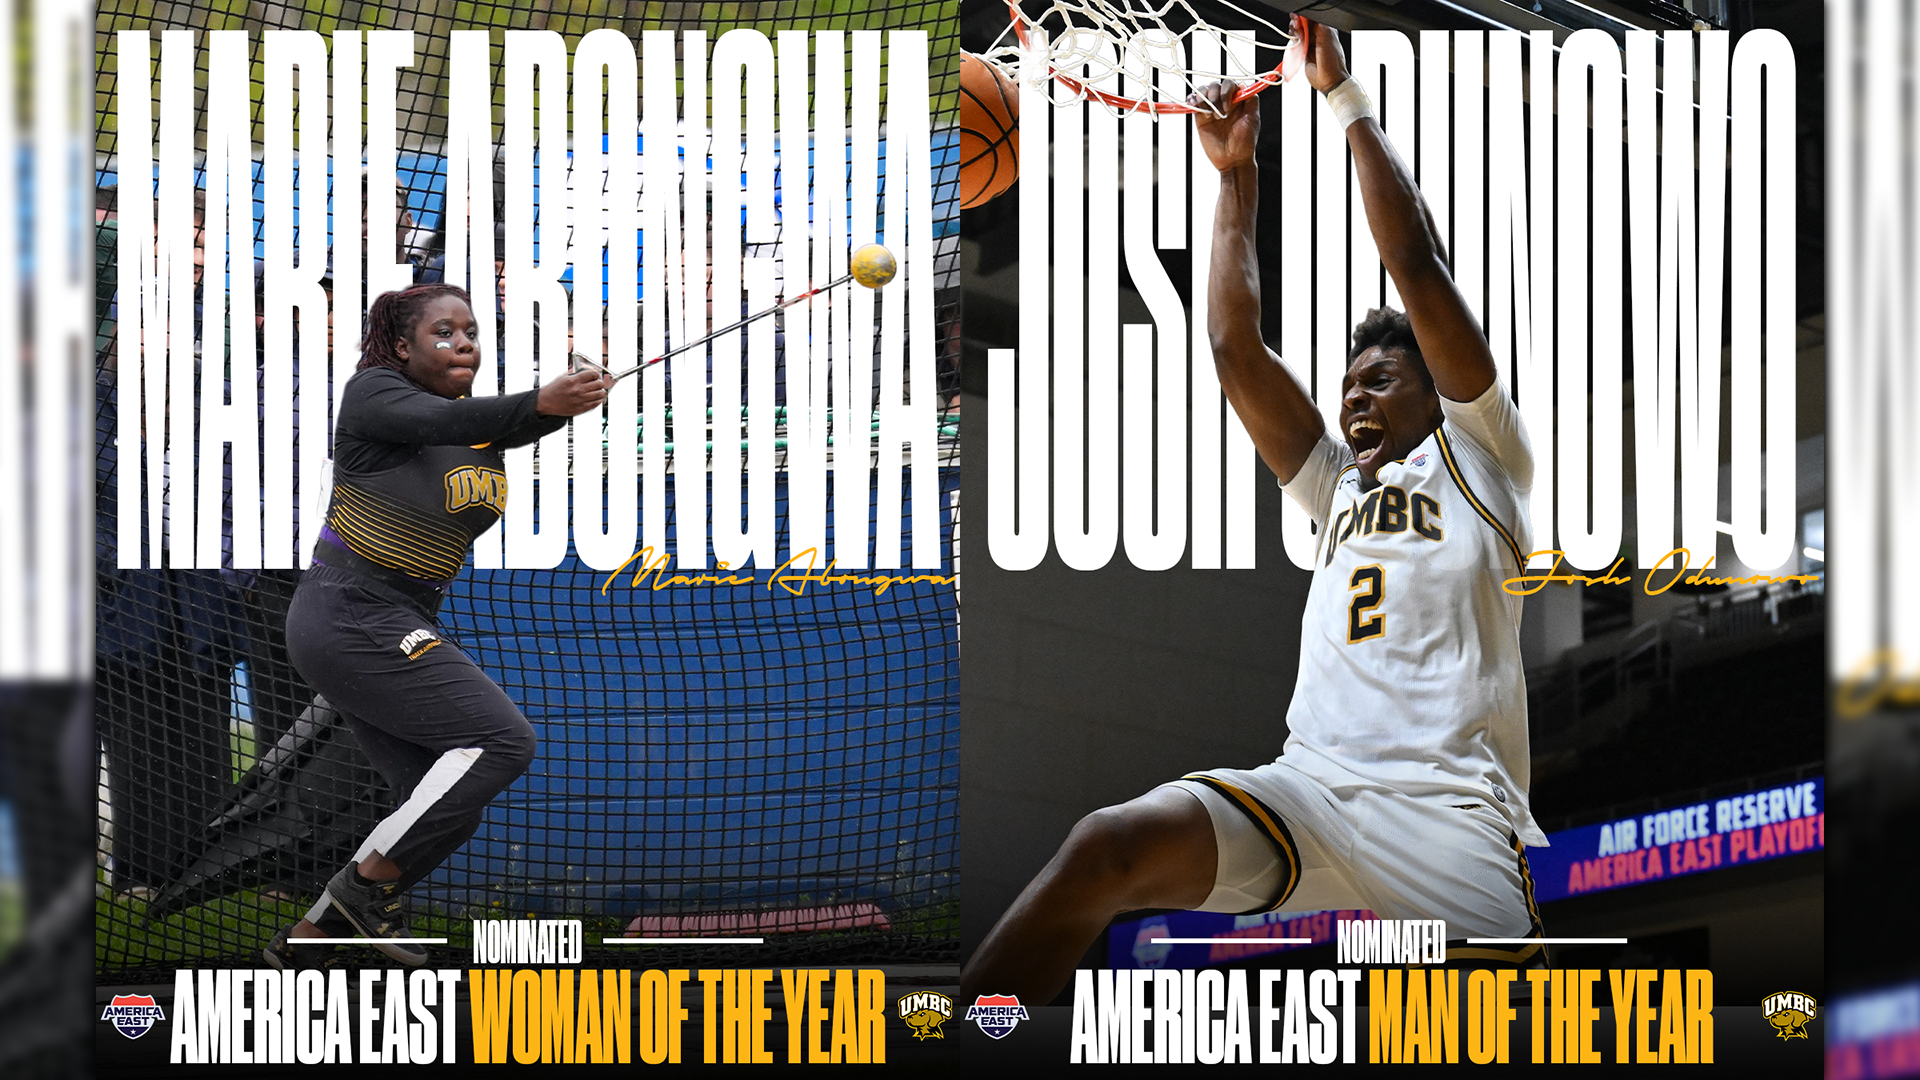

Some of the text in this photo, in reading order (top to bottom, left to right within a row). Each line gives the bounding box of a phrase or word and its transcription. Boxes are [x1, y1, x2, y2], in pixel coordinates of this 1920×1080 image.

[1324, 486, 1444, 569] UMBC
[1347, 563, 1386, 645] 2
[1599, 782, 1817, 858] AIR FORCE RESERVE
[1568, 847, 1663, 894] AMERICA
[1670, 833, 1722, 874] EAST
